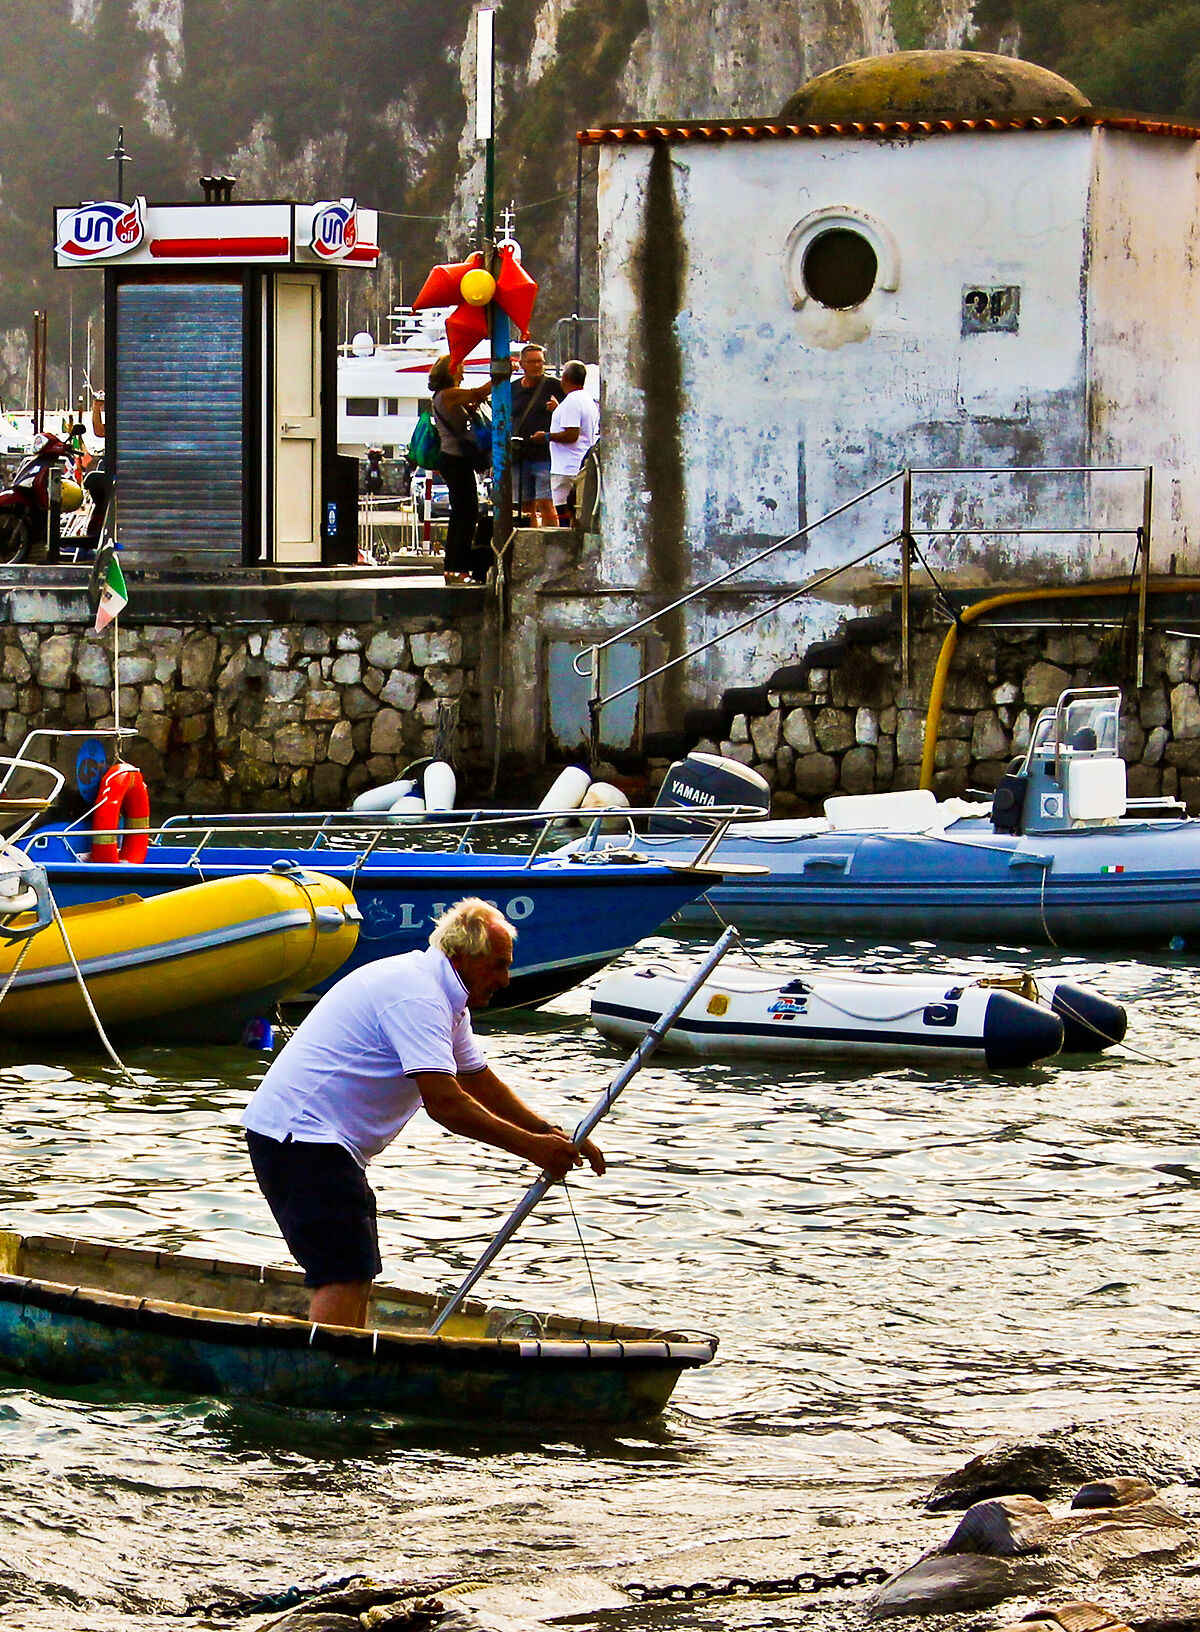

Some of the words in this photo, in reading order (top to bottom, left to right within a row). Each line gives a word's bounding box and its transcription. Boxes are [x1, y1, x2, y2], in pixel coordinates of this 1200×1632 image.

[120, 231, 134, 242] oil
[671, 780, 716, 807] YAMAHA
[399, 896, 535, 929] LO
